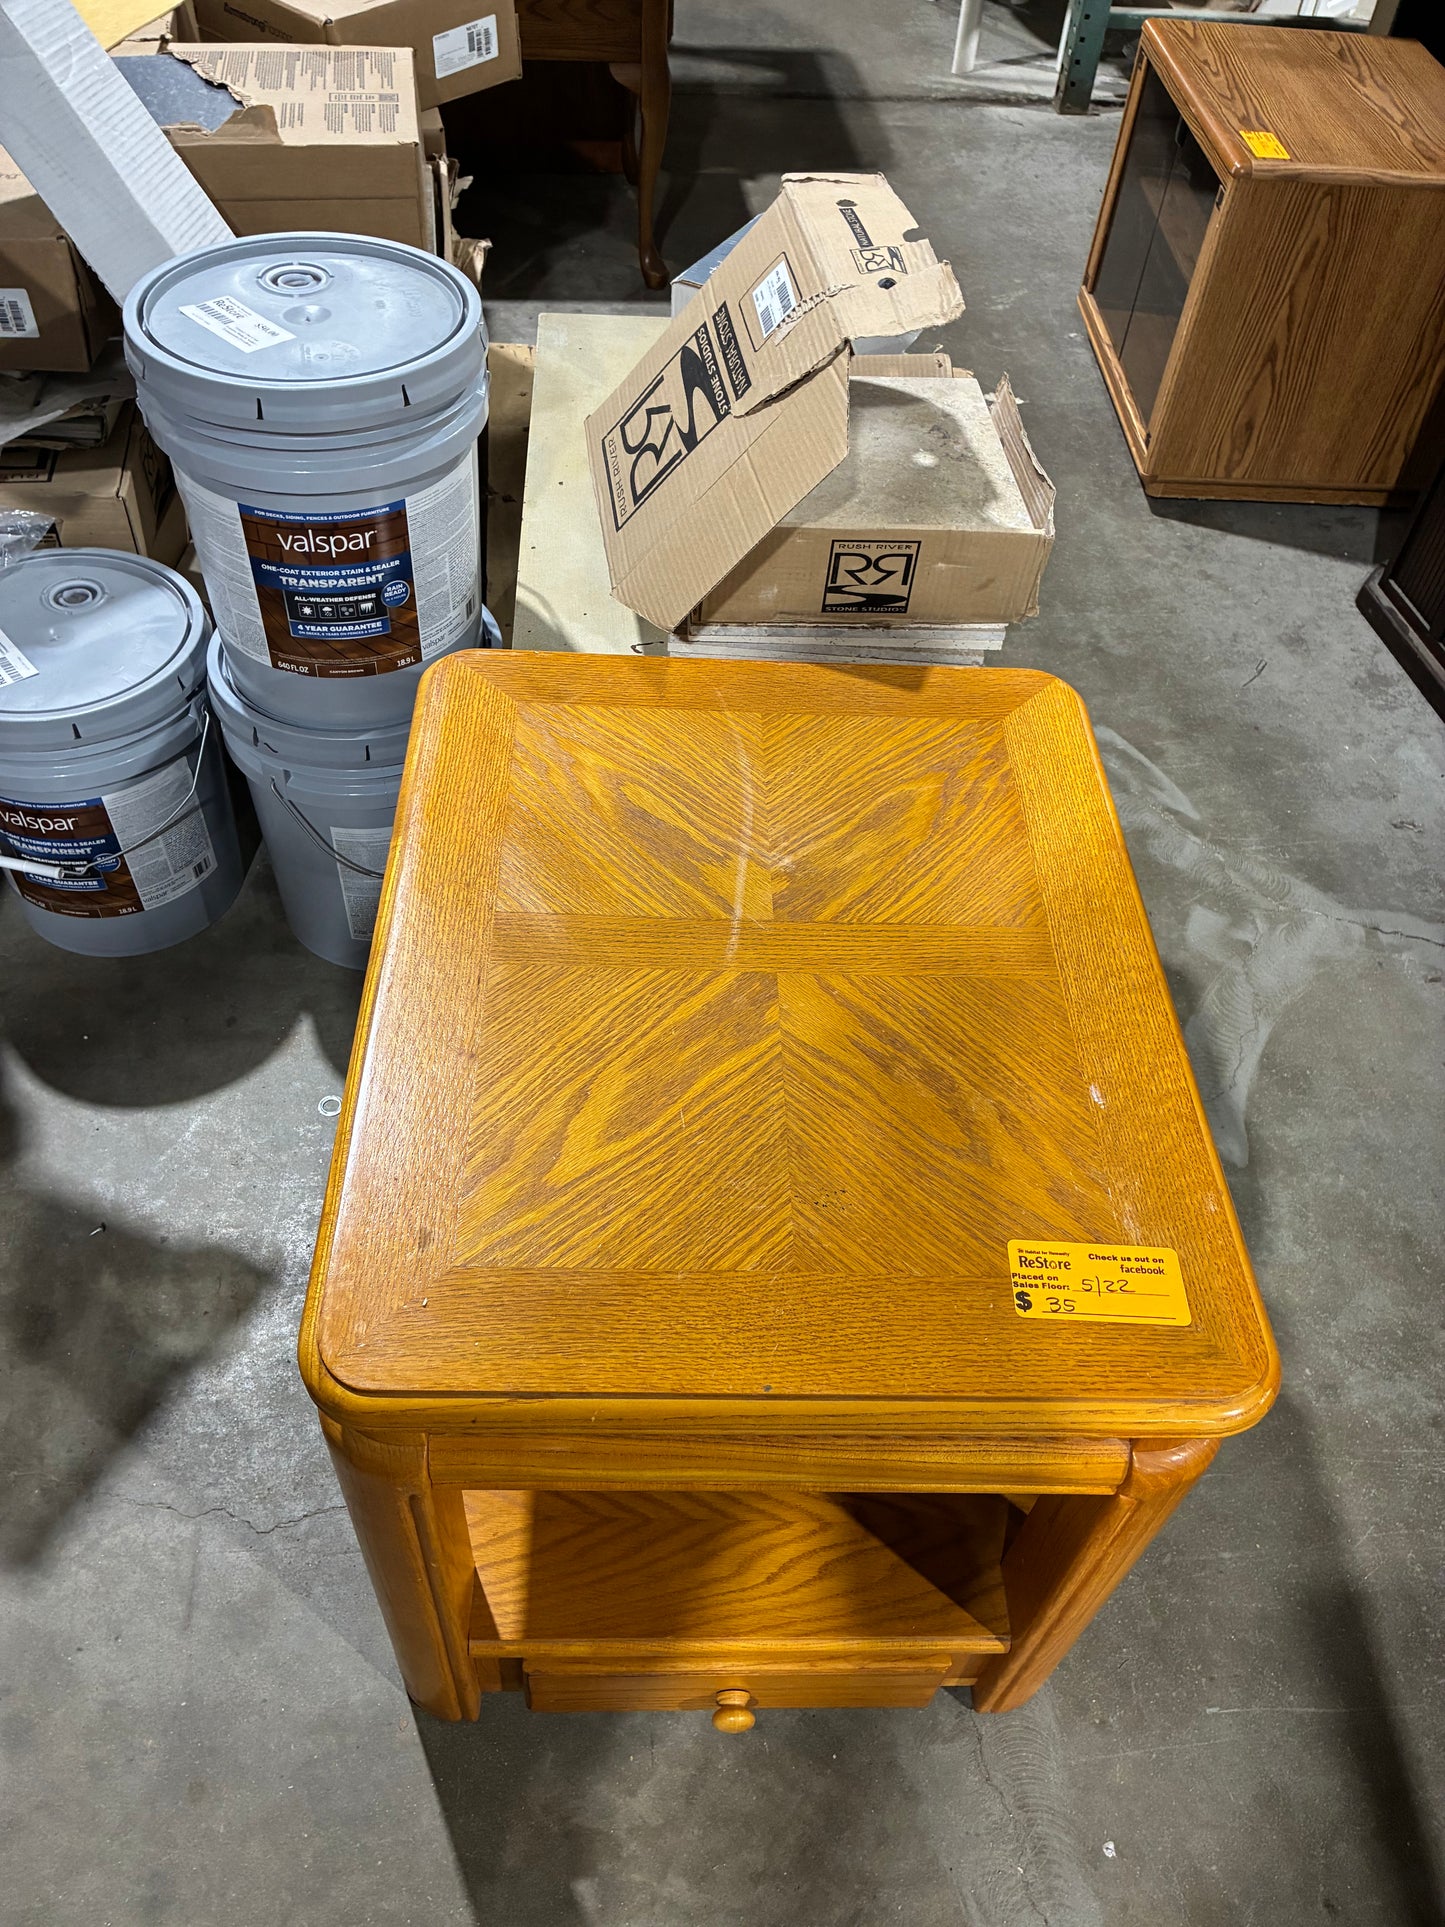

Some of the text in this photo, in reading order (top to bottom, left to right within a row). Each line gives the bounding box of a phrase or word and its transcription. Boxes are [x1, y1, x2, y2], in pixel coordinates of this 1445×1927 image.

[213, 300, 245, 318] ReStore
[715, 307, 748, 395] NATURAL STONE
[697, 327, 728, 416] STONE STUDIOS
[608, 437, 628, 517] RUSH RIVER
[361, 507, 390, 517] FURNITURE
[276, 529, 376, 558] valspar
[261, 563, 300, 575] ONE-COAT
[341, 568, 364, 576] STAIN
[372, 560, 400, 571] SEALER
[279, 572, 385, 588] TRANSPARENT
[294, 593, 376, 603] ALL-WEATHER DEFENSE
[384, 583, 407, 598] RAIN READY
[329, 621, 383, 632] GUARANTEE
[422, 632, 447, 650] valspar
[277, 660, 309, 674] 640 FL OZ
[397, 657, 411, 667] 18.9
[0, 811, 77, 834] valspar
[7, 837, 92, 855] TRANSPARENT
[20, 836, 52, 846] EXTERIOR
[79, 839, 106, 847] SEALER
[142, 890, 168, 903] valspar
[1018, 1255, 1071, 1270] ReStore
[1088, 1253, 1118, 1262] Check
[1011, 1272, 1044, 1280] Placed
[1120, 1264, 1165, 1275] facebook
[1012, 1281, 1039, 1289] Sales
[1041, 1282, 1070, 1290] Floor:
[1015, 1290, 1077, 1313] $ 35
